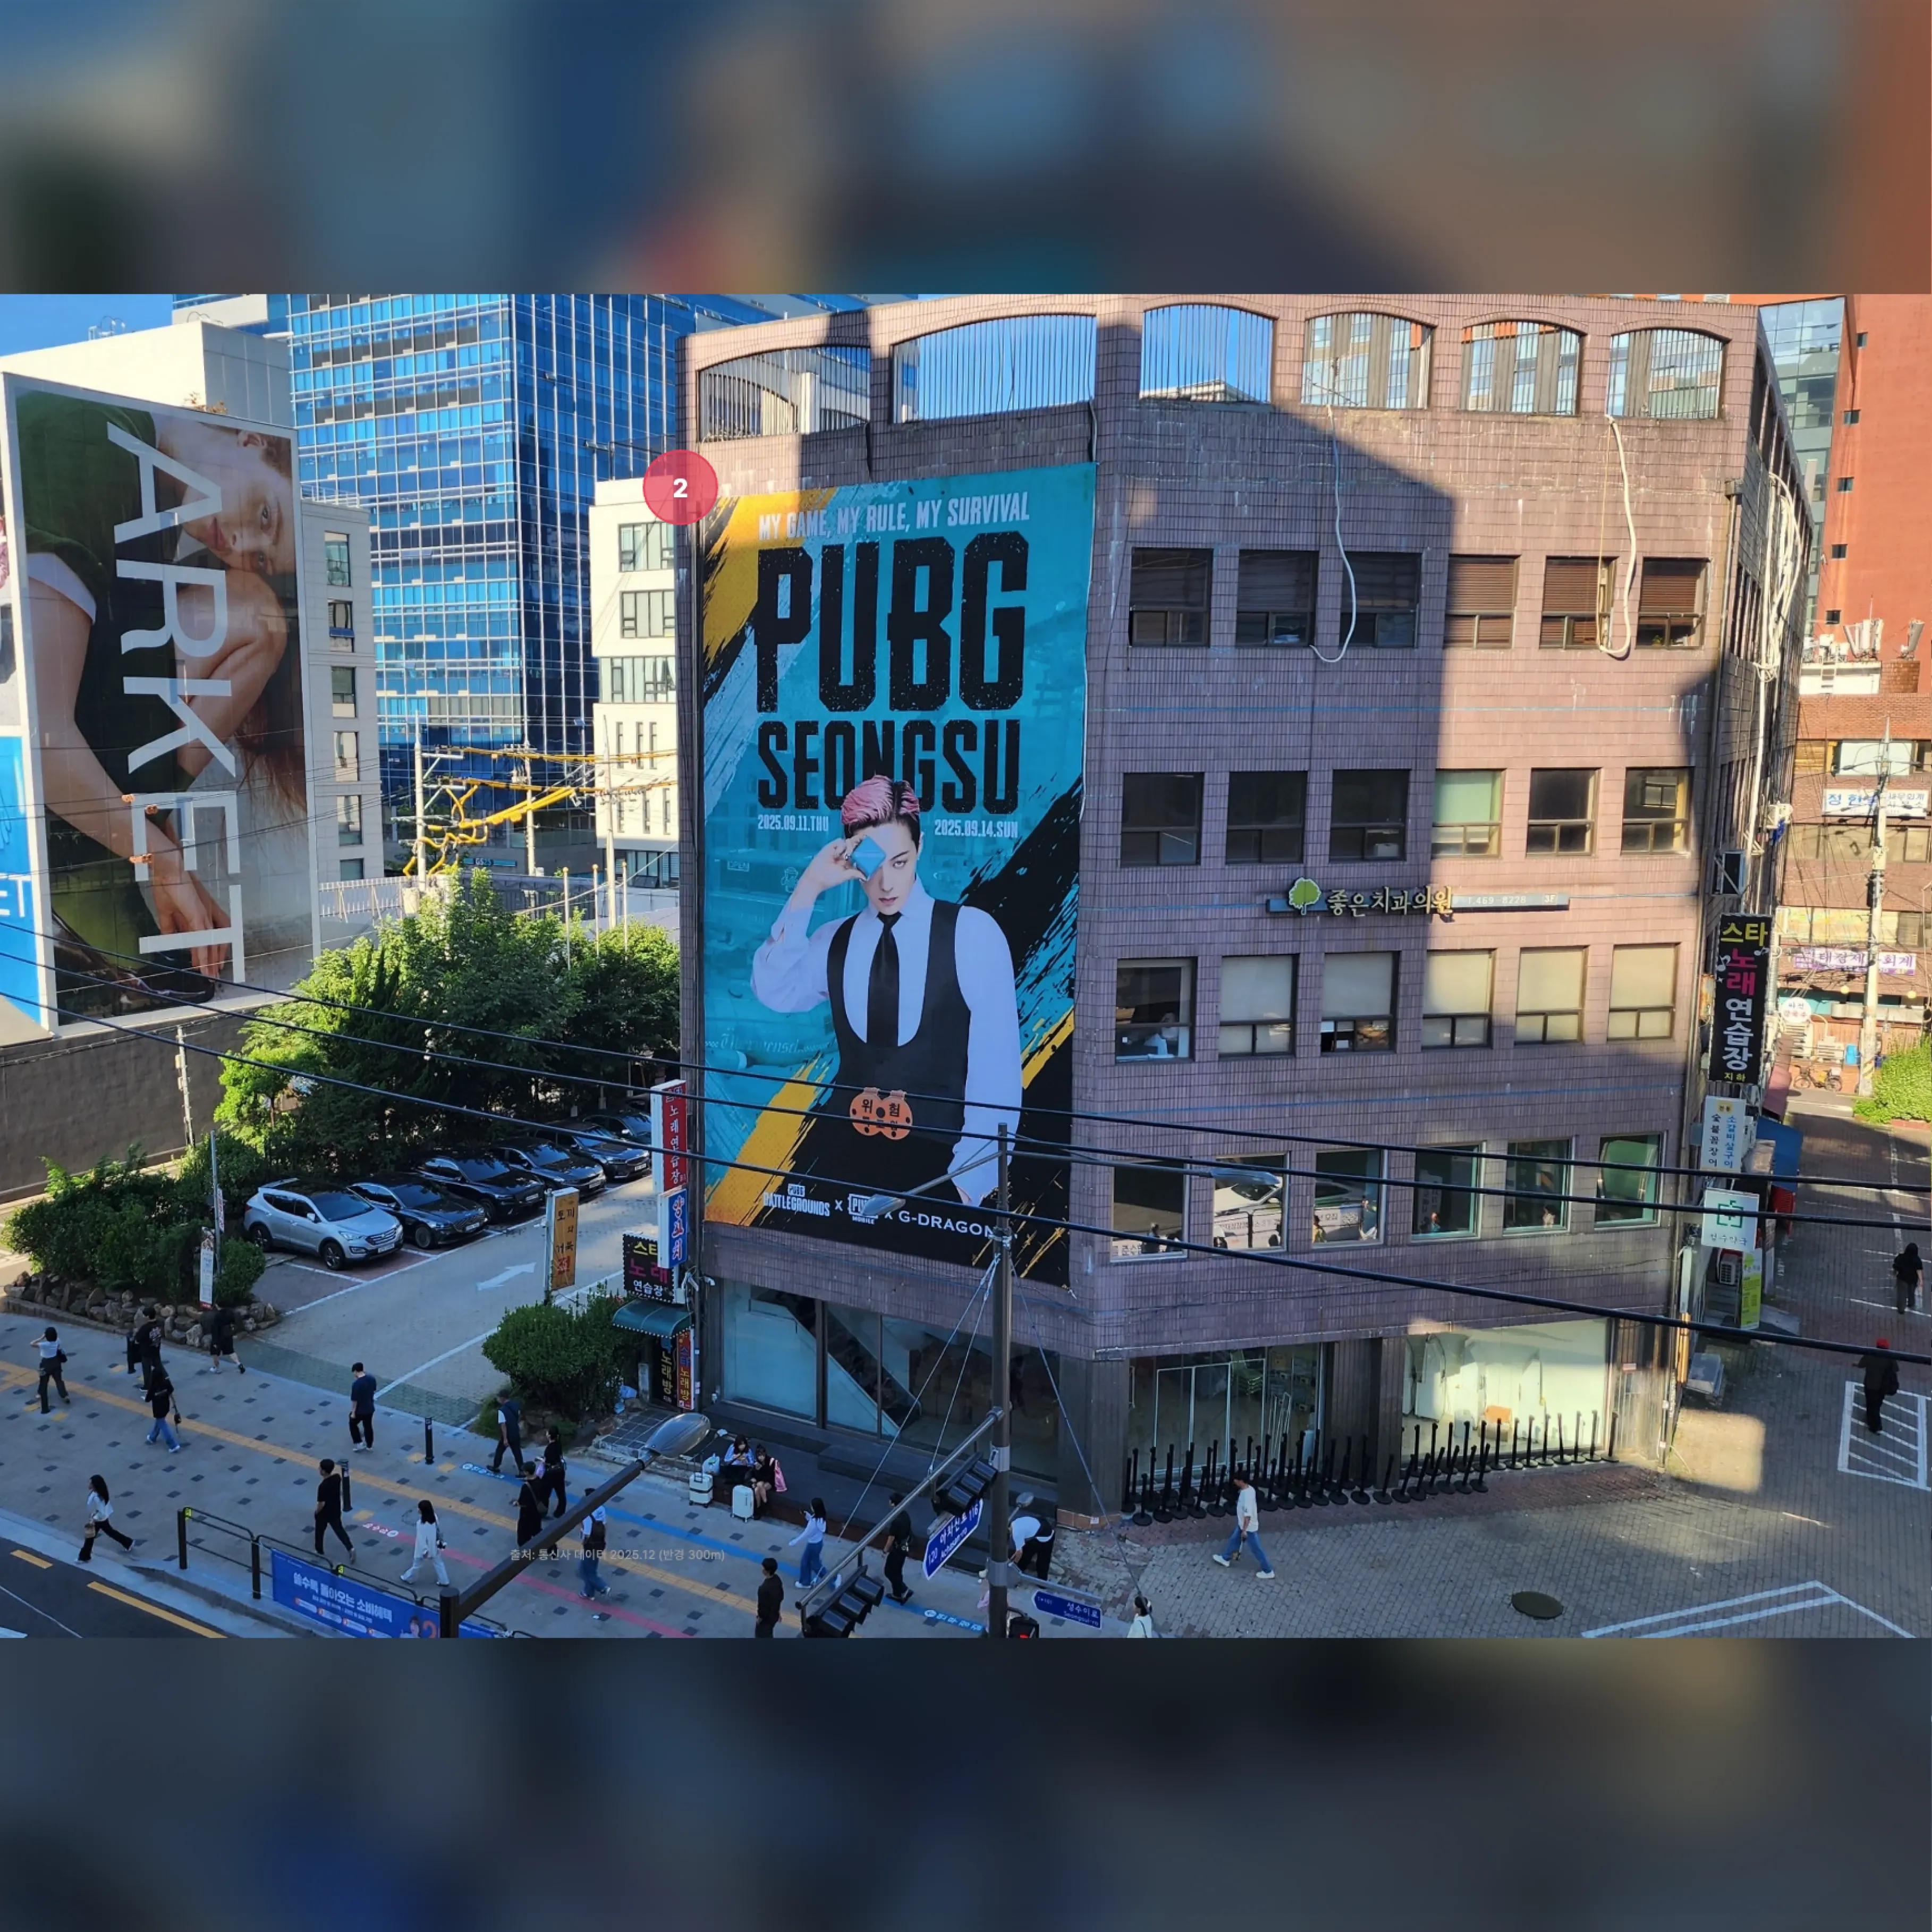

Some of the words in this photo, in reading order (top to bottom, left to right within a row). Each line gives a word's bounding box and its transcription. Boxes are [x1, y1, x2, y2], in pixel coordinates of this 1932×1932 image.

[759, 513, 781, 540] MY
[786, 509, 831, 538] GAME,
[837, 505, 860, 534] MY
[867, 502, 910, 532] RULE,
[916, 498, 942, 529] MY
[947, 491, 1030, 528] SURVIVAL
[753, 531, 1030, 713] PUBG
[107, 422, 245, 983] ARKET
[757, 719, 1021, 815] SEONGSU
[757, 814, 829, 832] 2025.09.11.THU
[934, 819, 1019, 838] 2025.09.14.SUN
[1329, 885, 1453, 917] 좋은치과의원
[1544, 894, 1557, 904] 3F
[1721, 922, 1768, 946] 스타
[1722, 947, 1758, 1071] 노래연습장
[1724, 1071, 1746, 1083] 지하
[861, 1099, 900, 1117] 위험
[669, 1104, 681, 1185] 노래연습장
[788, 1184, 806, 1197] PUBG
[763, 1192, 830, 1217] BATTLEGROUNDS
[898, 1210, 996, 1239] G-DRAGON
[628, 1258, 668, 1284] 노래
[661, 1351, 673, 1395] 노래방
[680, 1367, 690, 1402] 노래방
[1066, 1601, 1099, 1619] 성수이로
